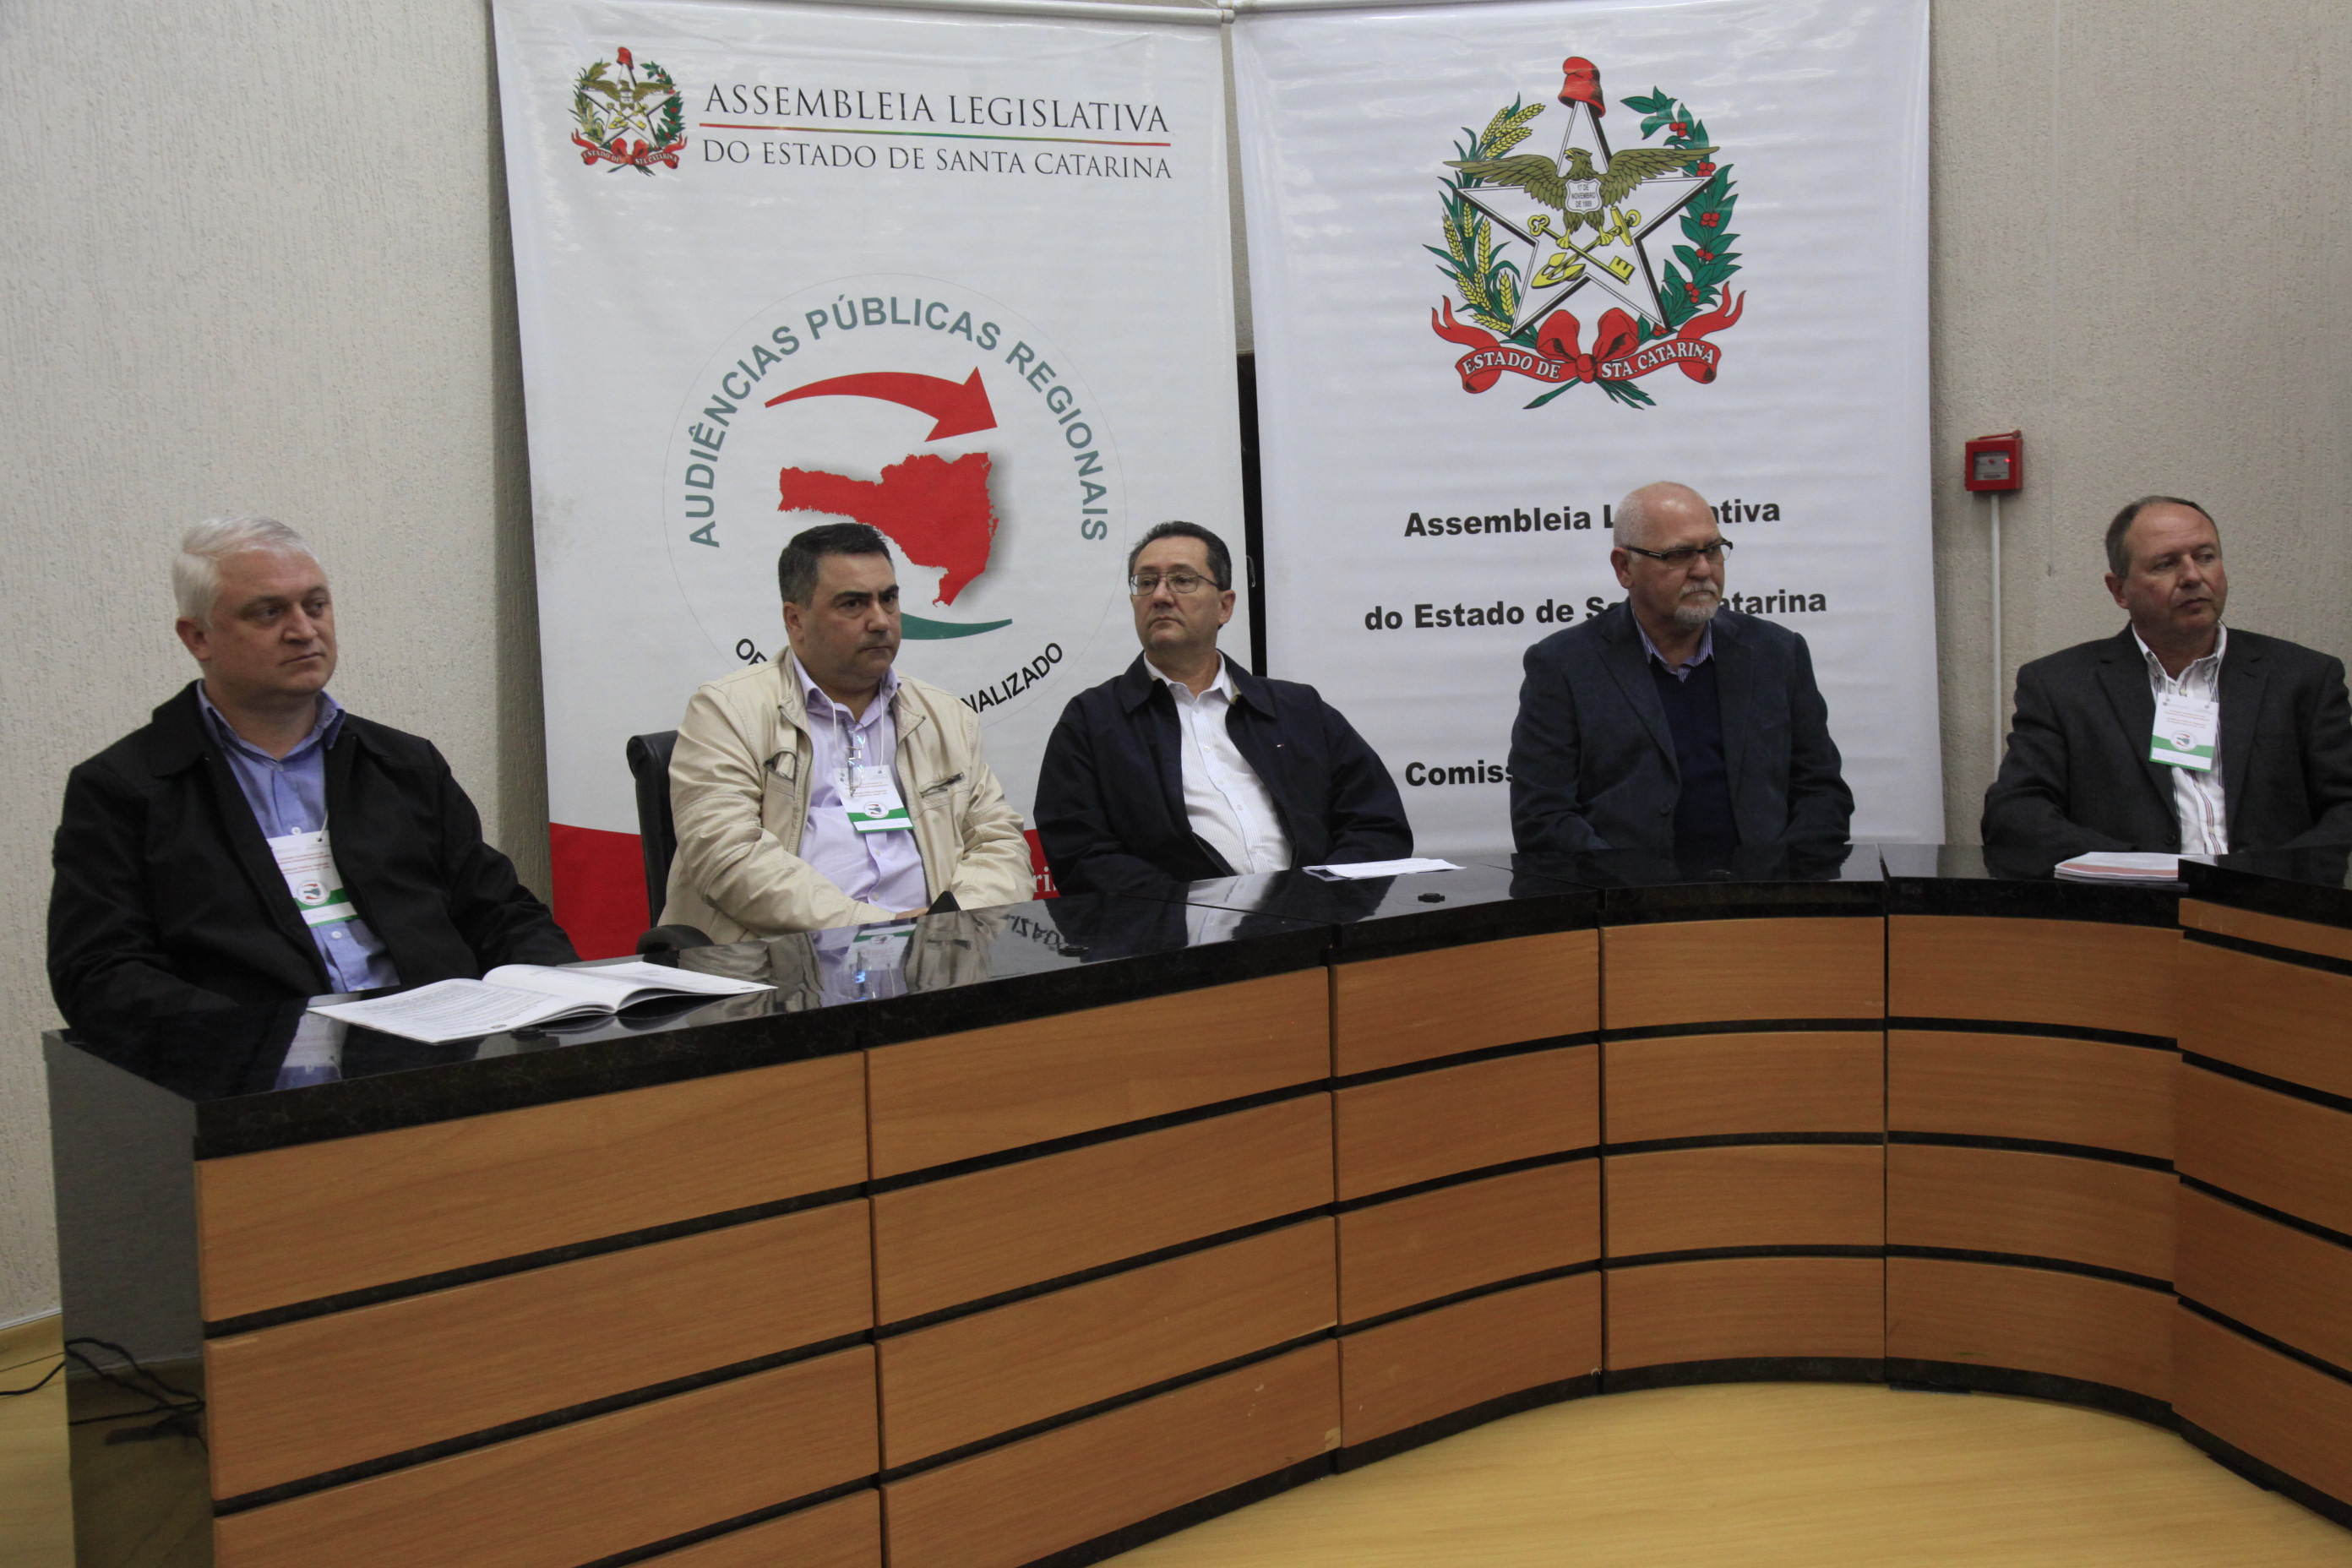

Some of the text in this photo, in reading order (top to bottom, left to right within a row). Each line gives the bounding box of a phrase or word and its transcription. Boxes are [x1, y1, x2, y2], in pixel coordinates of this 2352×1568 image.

[705, 84, 1170, 132] ASSEMBLEIA LEGISLATIVA
[703, 139, 1173, 178] DO ESTADO DE SANTA CATARINA
[1462, 351, 1533, 375] ESTADO
[1535, 361, 1561, 378] DE
[1638, 341, 1714, 369] CATARINA
[684, 294, 1108, 548] AUDIÊNCIAS PÚBLICAS REGIONAIS
[1404, 506, 1592, 537] Assembleia
[1364, 606, 1403, 630] do
[1414, 601, 1525, 629] Estado
[1536, 599, 1574, 623] de
[1719, 589, 1827, 614] atarina
